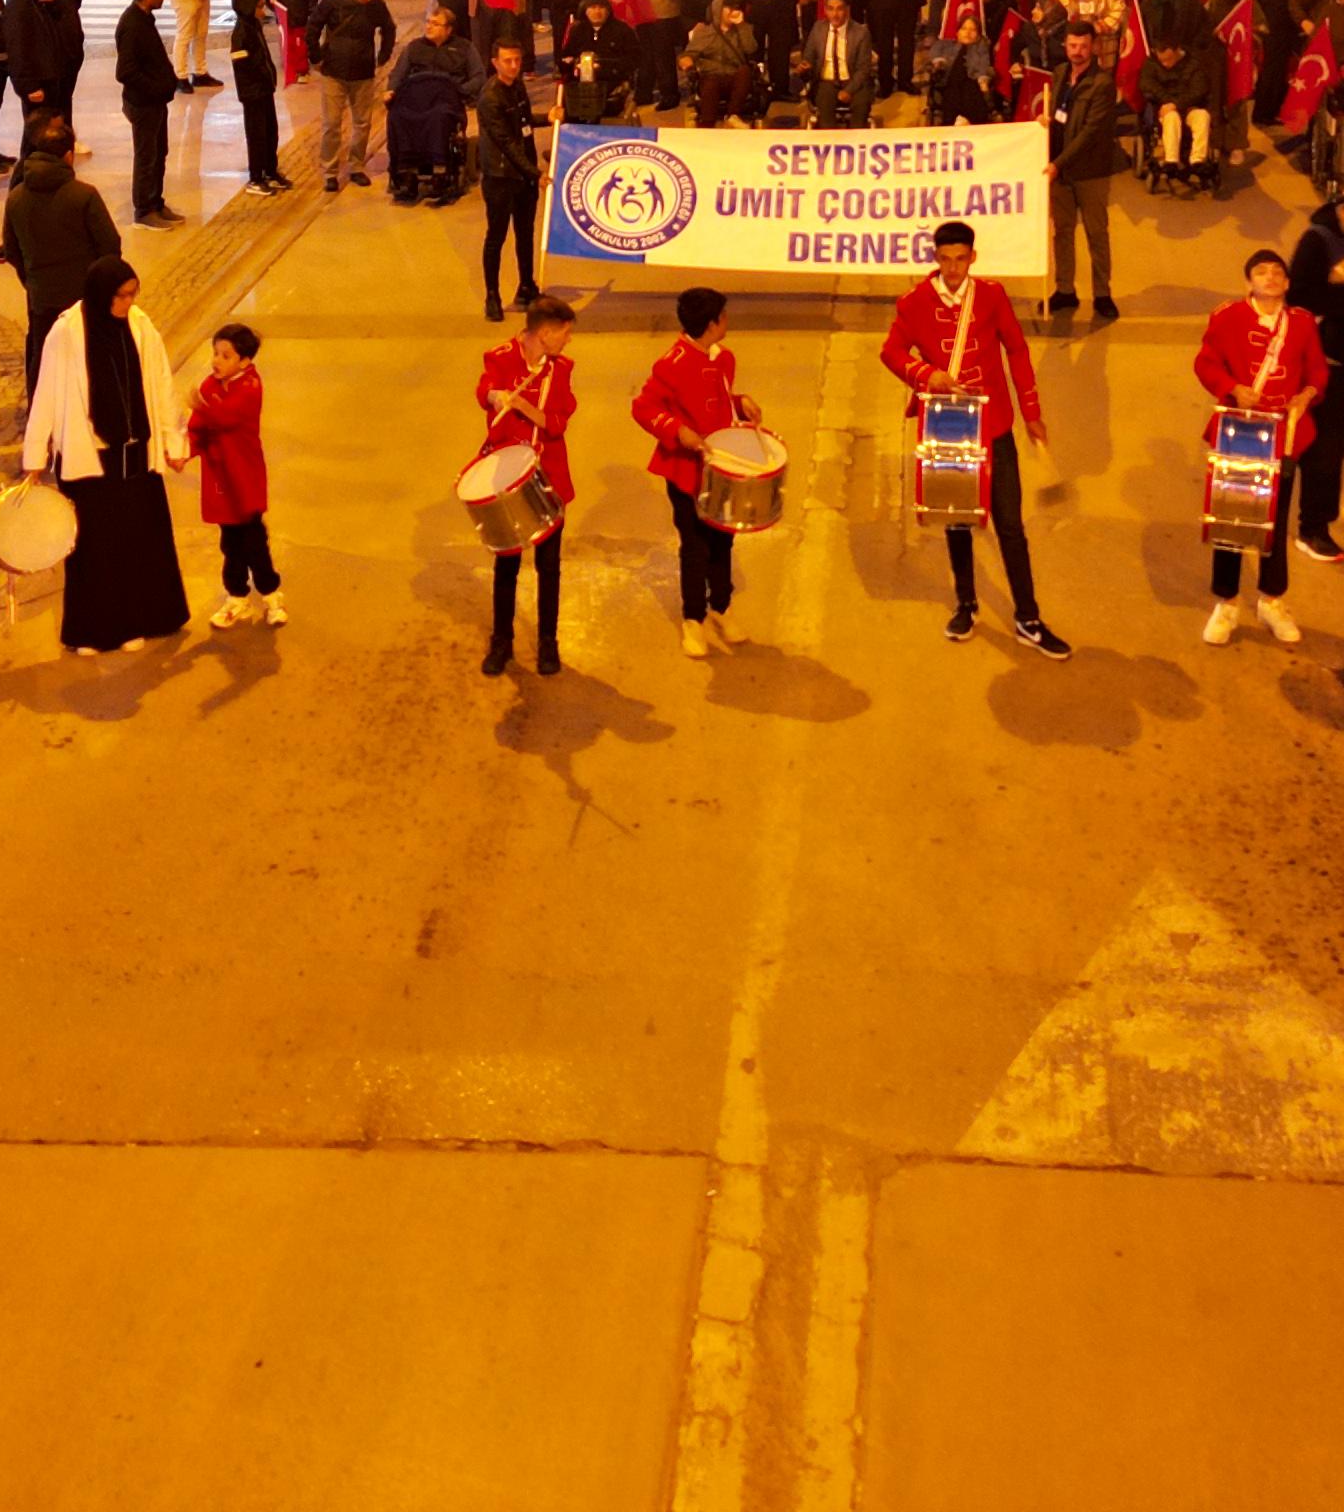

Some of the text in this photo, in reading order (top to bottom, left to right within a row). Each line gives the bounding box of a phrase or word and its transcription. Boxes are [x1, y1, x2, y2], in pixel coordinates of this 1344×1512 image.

[714, 180, 1026, 224] ÜMİT ÇOCUKLARI
[786, 225, 936, 265] DERNEĞ
